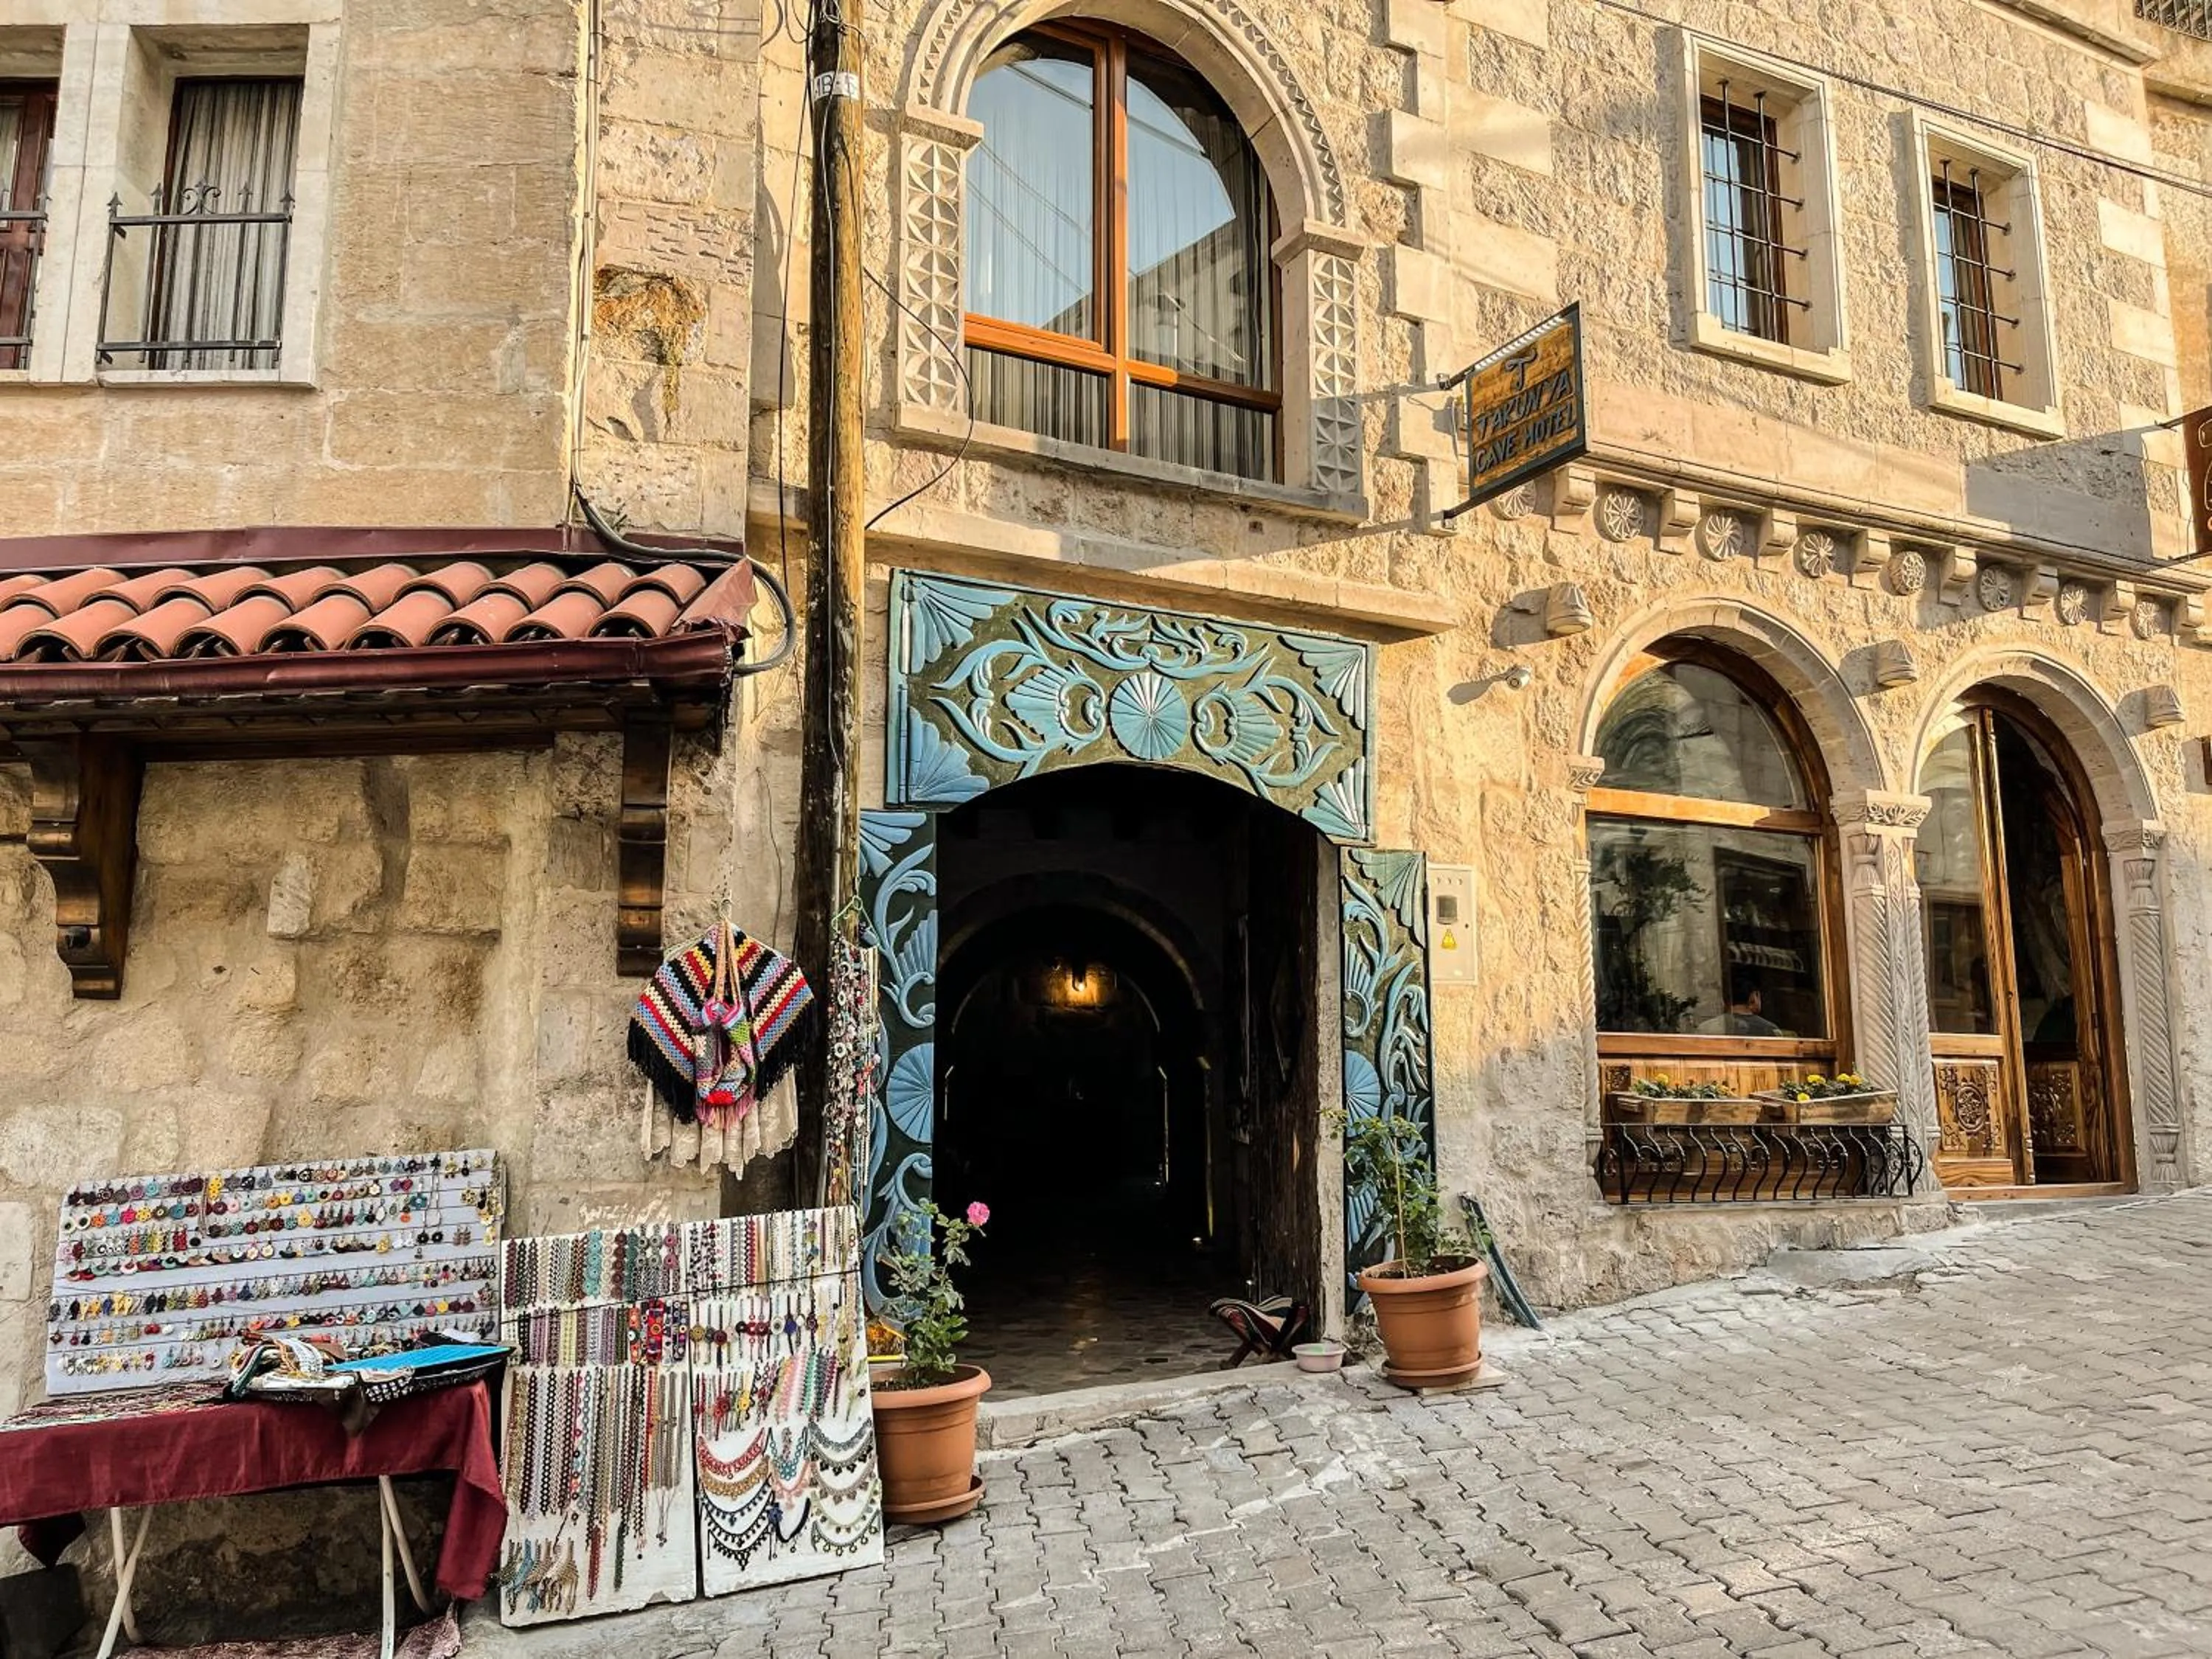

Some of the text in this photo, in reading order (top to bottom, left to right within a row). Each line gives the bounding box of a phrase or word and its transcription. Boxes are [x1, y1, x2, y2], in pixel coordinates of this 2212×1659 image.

[1478, 369, 1573, 441] TAKUNYA
[1505, 348, 1538, 391] T
[1476, 402, 1577, 473] CAVE HOTEL
